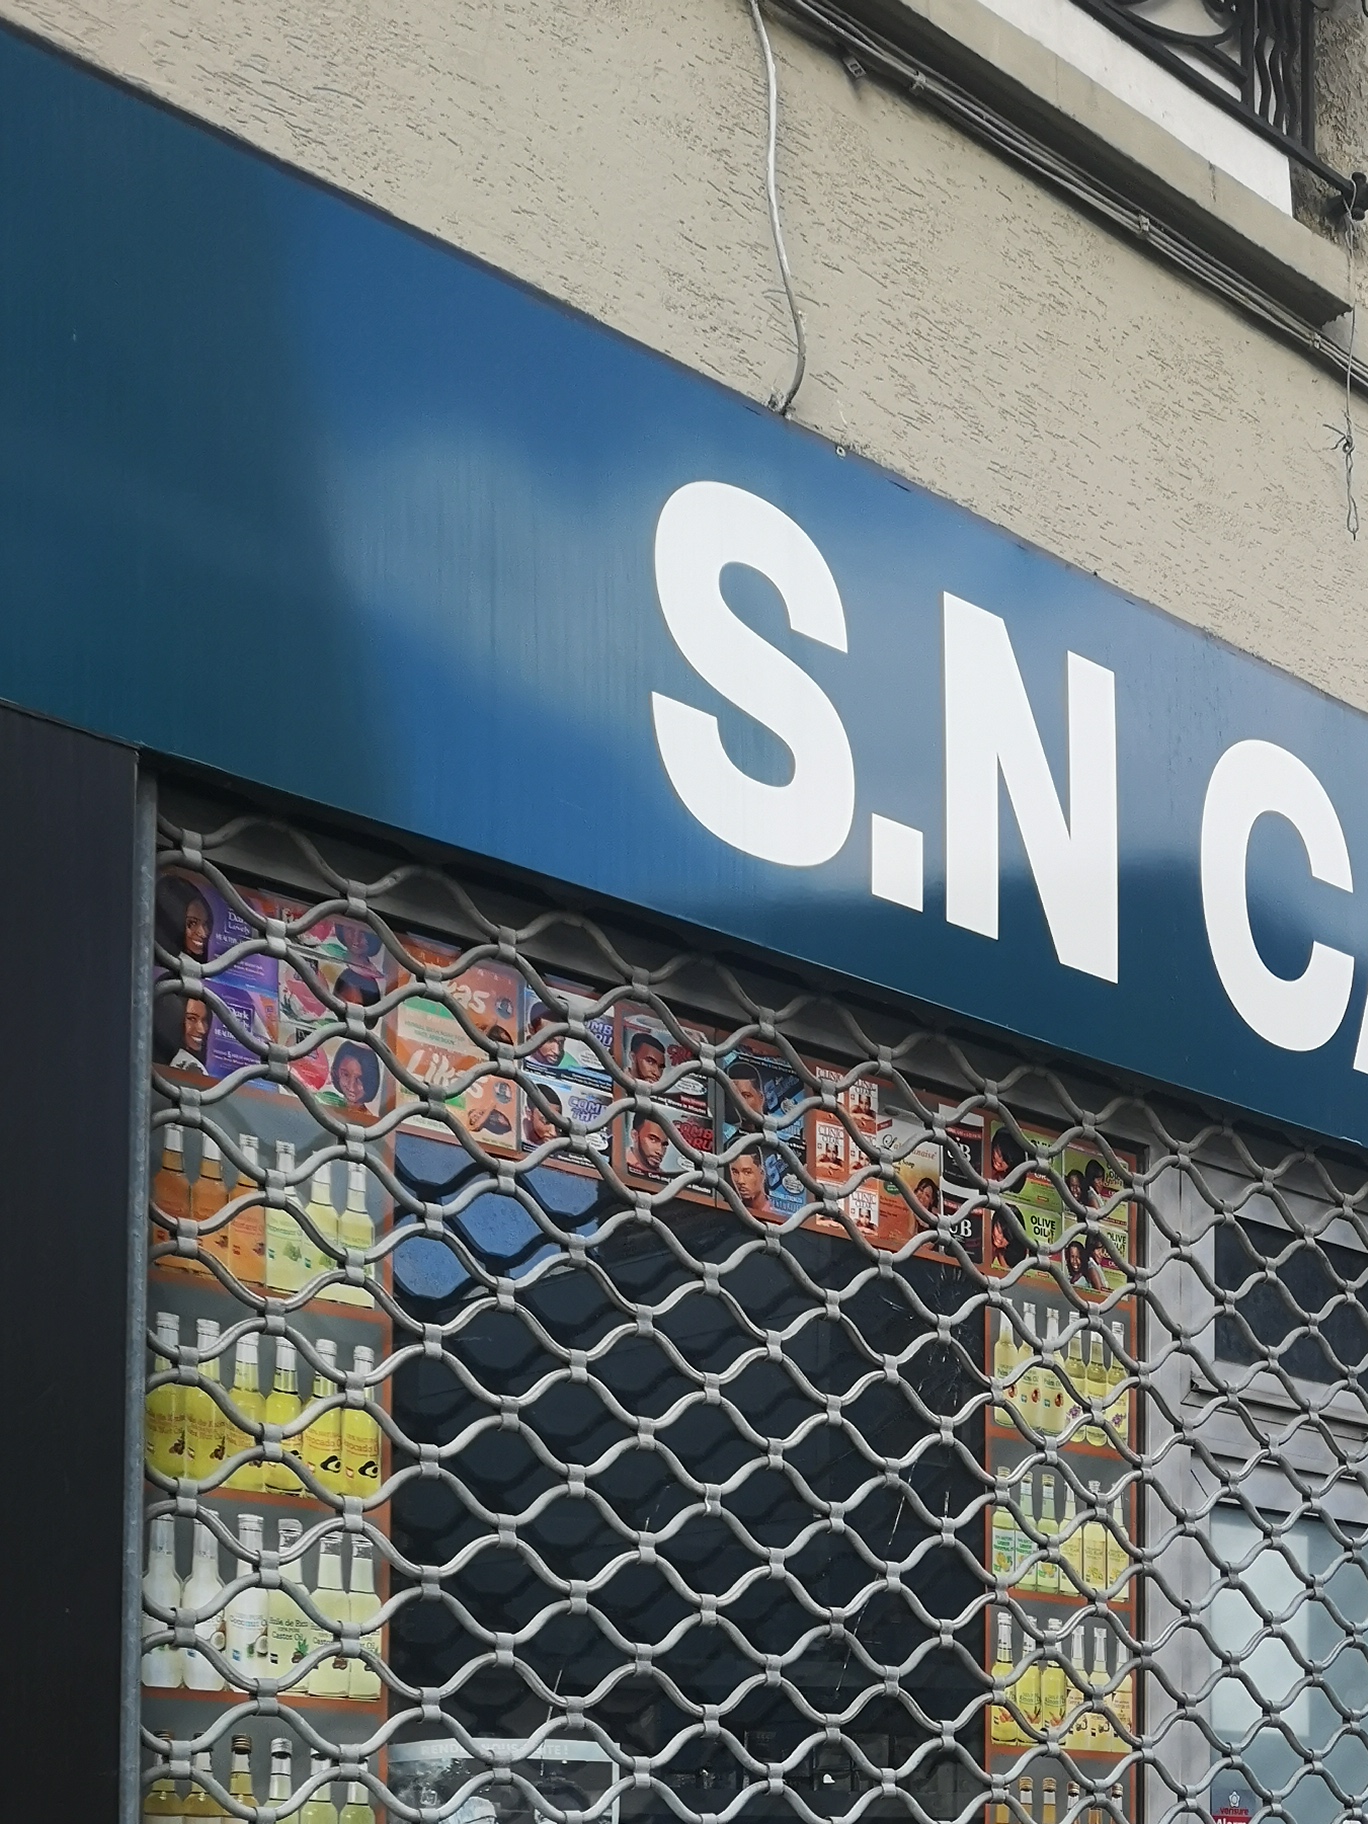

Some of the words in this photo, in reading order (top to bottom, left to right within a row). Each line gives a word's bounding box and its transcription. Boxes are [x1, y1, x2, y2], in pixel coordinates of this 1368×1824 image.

[652, 480, 1118, 984] S.N
[405, 1049, 491, 1099] Liks
[1030, 1215, 1056, 1230] OLIVE
